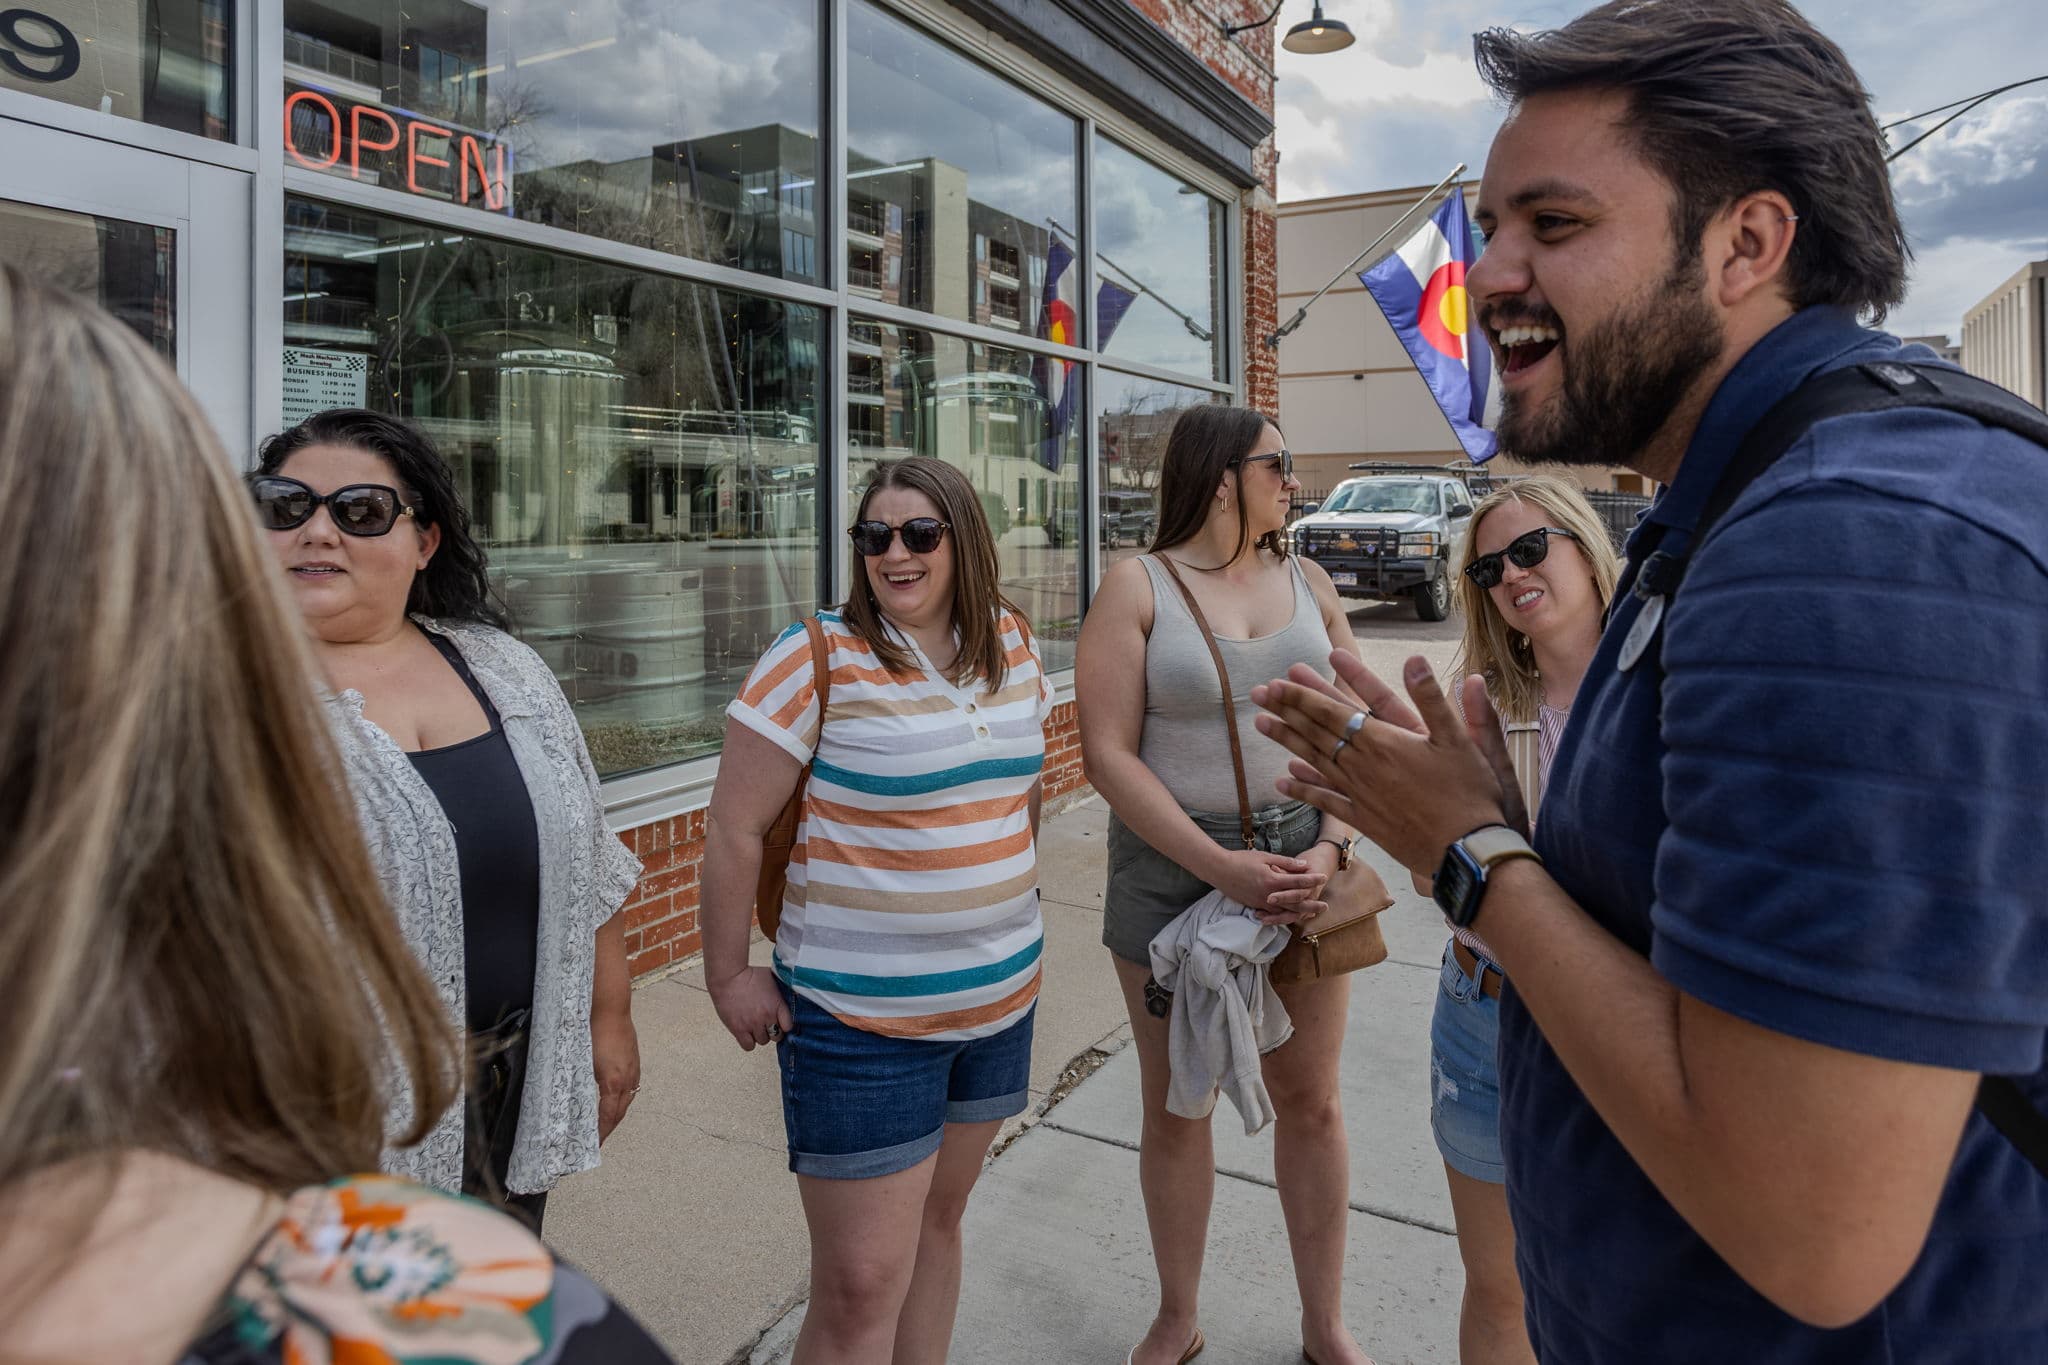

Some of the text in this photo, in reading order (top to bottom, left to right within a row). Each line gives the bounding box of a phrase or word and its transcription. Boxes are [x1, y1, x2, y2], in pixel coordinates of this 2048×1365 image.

[285, 91, 503, 210] OPEN
[287, 367, 352, 379] BUSINESS HOURS
